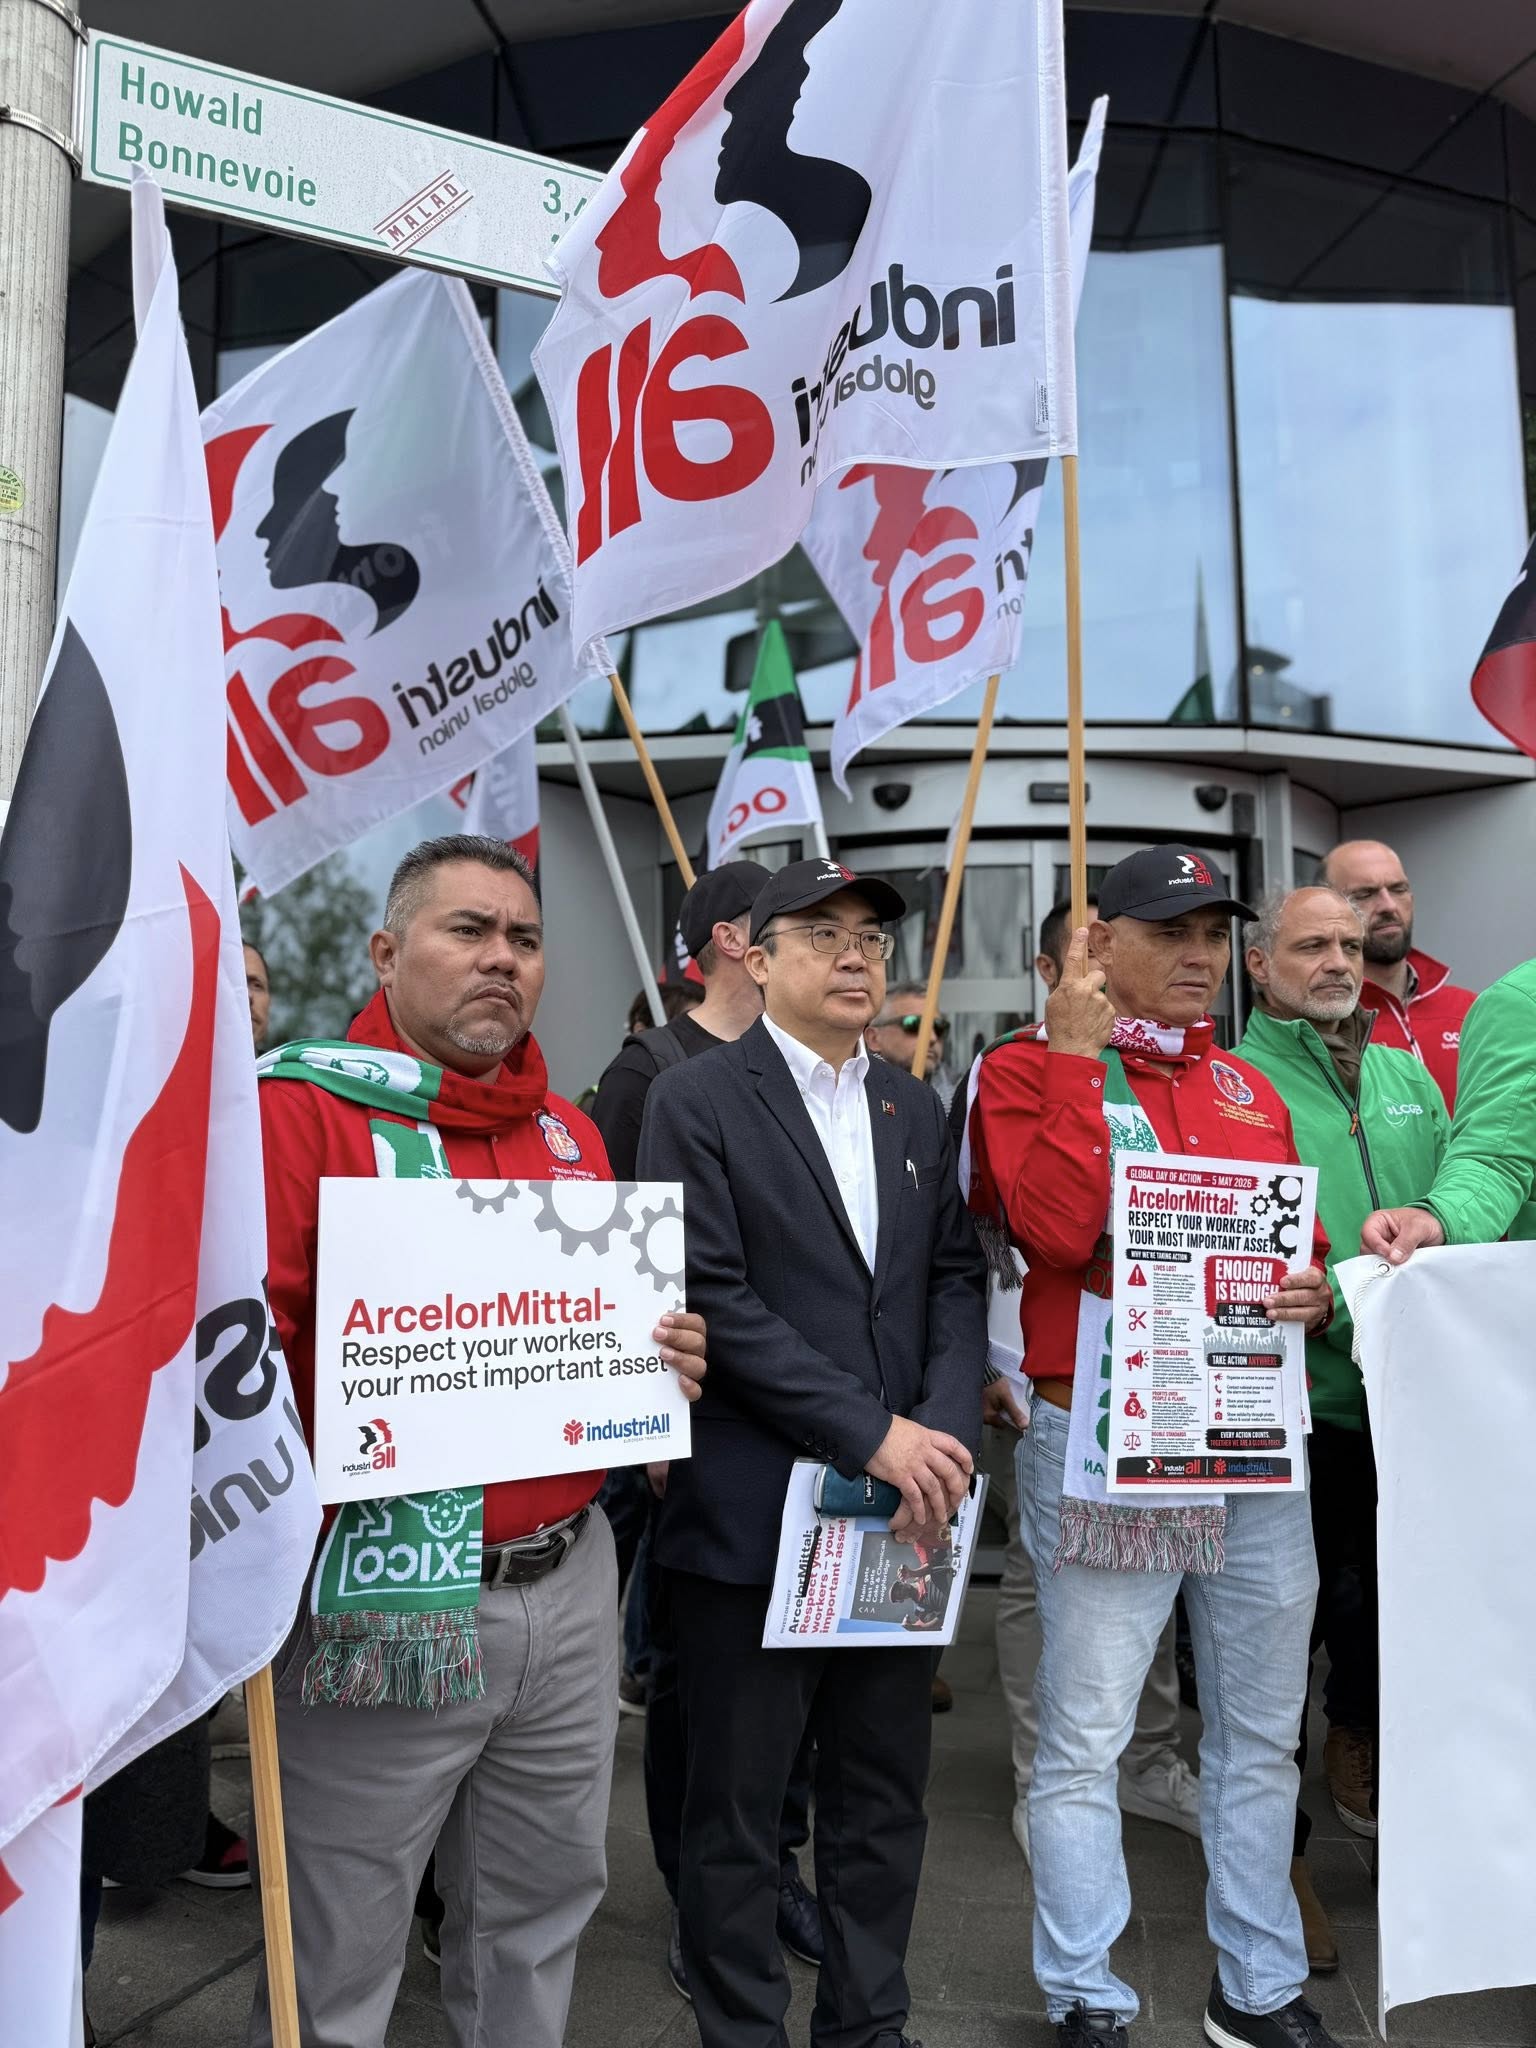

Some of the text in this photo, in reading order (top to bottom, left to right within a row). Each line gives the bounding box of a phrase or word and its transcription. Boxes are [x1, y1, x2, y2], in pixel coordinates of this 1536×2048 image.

[120, 61, 262, 136] Howald
[117, 121, 317, 207] Bonnevoie
[387, 183, 460, 242] MALAD
[1442, 1031, 1460, 1042] OG
[1130, 1169, 1251, 1188] GLOBAL DAY OF ACTION 5 MAY 2026
[1128, 1185, 1238, 1216] ArcelorMittal:
[1128, 1211, 1256, 1234] RESPECT YOUR WORKERS
[1129, 1229, 1275, 1253] YOUR MOST IMPORTANT ASSET
[1215, 1259, 1273, 1282] ENOUGH
[1215, 1281, 1227, 1300] IS
[341, 1287, 616, 1336] ArcelorMittal-
[1219, 1316, 1227, 1324] WE
[1228, 1316, 1245, 1324] STAND
[1229, 1305, 1250, 1315] 5 MAY
[342, 1327, 622, 1370] Respect your workers,
[1212, 1355, 1226, 1365] TAKE
[1227, 1356, 1247, 1365] ACTION
[341, 1354, 668, 1405] your most important asset
[587, 1413, 670, 1441] industriAll
[343, 1462, 370, 1472] industri
[372, 1446, 395, 1470] all
[1185, 1459, 1200, 1474] all
[875, 1540, 886, 1575] Chemicals
[788, 1530, 813, 1634] ArcelorMittal:
[811, 1524, 836, 1634] workers your
[821, 1518, 847, 1634] important asset
[879, 1559, 891, 1603] weighbridge
[799, 1572, 818, 1634] Respect
[859, 1584, 867, 1602] Main
[866, 1585, 874, 1602] East
[872, 1583, 880, 1603] Coke
[780, 1605, 789, 1634] INVESTOR
